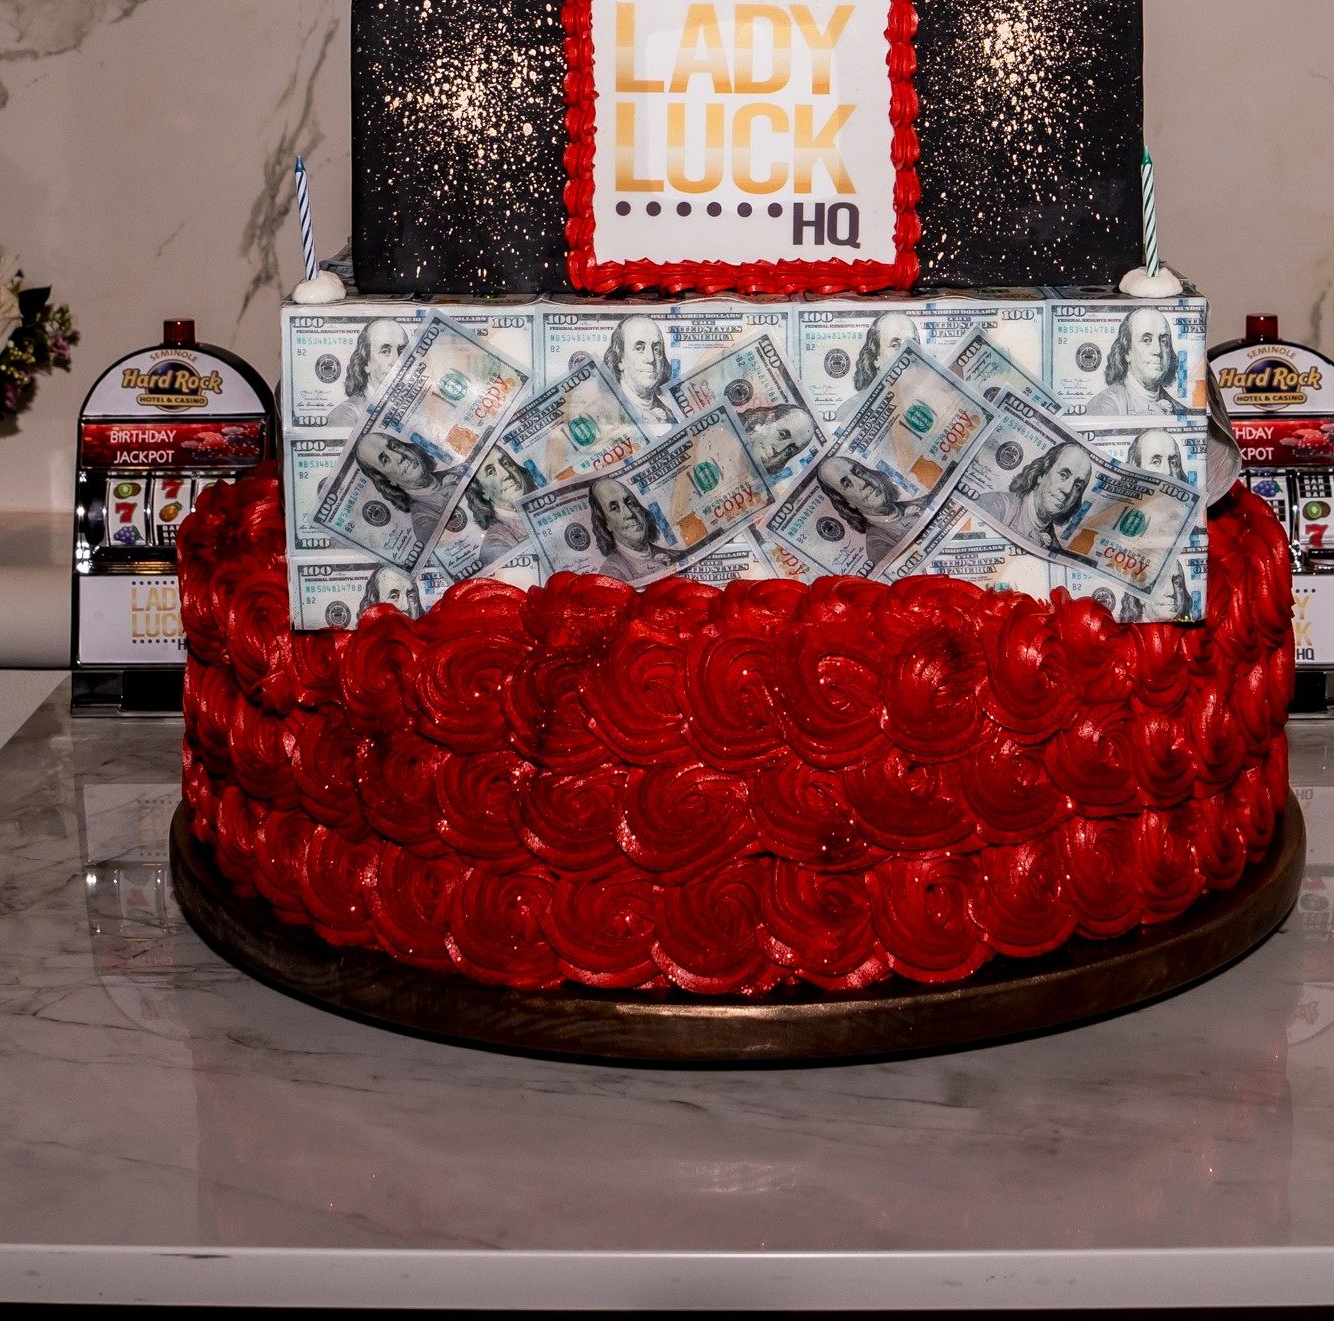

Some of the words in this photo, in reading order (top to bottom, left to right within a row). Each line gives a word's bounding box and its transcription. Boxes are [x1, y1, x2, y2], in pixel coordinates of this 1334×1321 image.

[614, 2, 857, 95] LADY
[614, 102, 857, 195] LUCK
[792, 201, 861, 249] HQ
[546, 313, 579, 325] 100
[746, 314, 780, 326] 100
[800, 311, 834, 324] 100
[1001, 309, 1035, 321] 100
[1054, 305, 1087, 318] 100
[292, 317, 325, 329] 100
[492, 317, 525, 329] 100
[416, 326, 440, 358] 100
[150, 349, 198, 364] SEMINOLE
[758, 339, 781, 370] 100
[1246, 346, 1298, 360] SEMINOLE
[122, 368, 175, 390] Hard
[175, 370, 224, 395] Rock
[561, 368, 591, 393] 100
[885, 356, 911, 387] 100
[1219, 368, 1272, 389] Hard
[1272, 366, 1323, 391] Rock
[139, 396, 165, 404] HOTEL
[175, 396, 205, 404] CASINO
[474, 374, 508, 419] copy
[1005, 395, 1035, 419] 100
[1272, 394, 1304, 402] CASINO
[298, 414, 330, 427] 100
[1064, 404, 1087, 416] 00
[689, 412, 720, 437] 100
[938, 410, 974, 455] copy
[1233, 427, 1274, 440] HDAY
[110, 429, 177, 443] BIRTHDAY
[293, 440, 326, 452] 100
[113, 450, 175, 464] JACKPOT
[592, 436, 634, 472] copy
[1240, 447, 1274, 461] KPOT
[529, 491, 557, 512] 100
[1160, 481, 1190, 503] 100
[115, 503, 137, 523] 7
[317, 491, 339, 523] 100
[713, 486, 755, 520] copy
[770, 502, 795, 531] 100
[301, 537, 331, 548] 100
[404, 540, 425, 572] 100
[896, 551, 923, 578] 100
[1104, 547, 1150, 575] copy
[300, 565, 333, 578] 100
[131, 587, 179, 612] LAD
[1296, 647, 1315, 661] HQ
